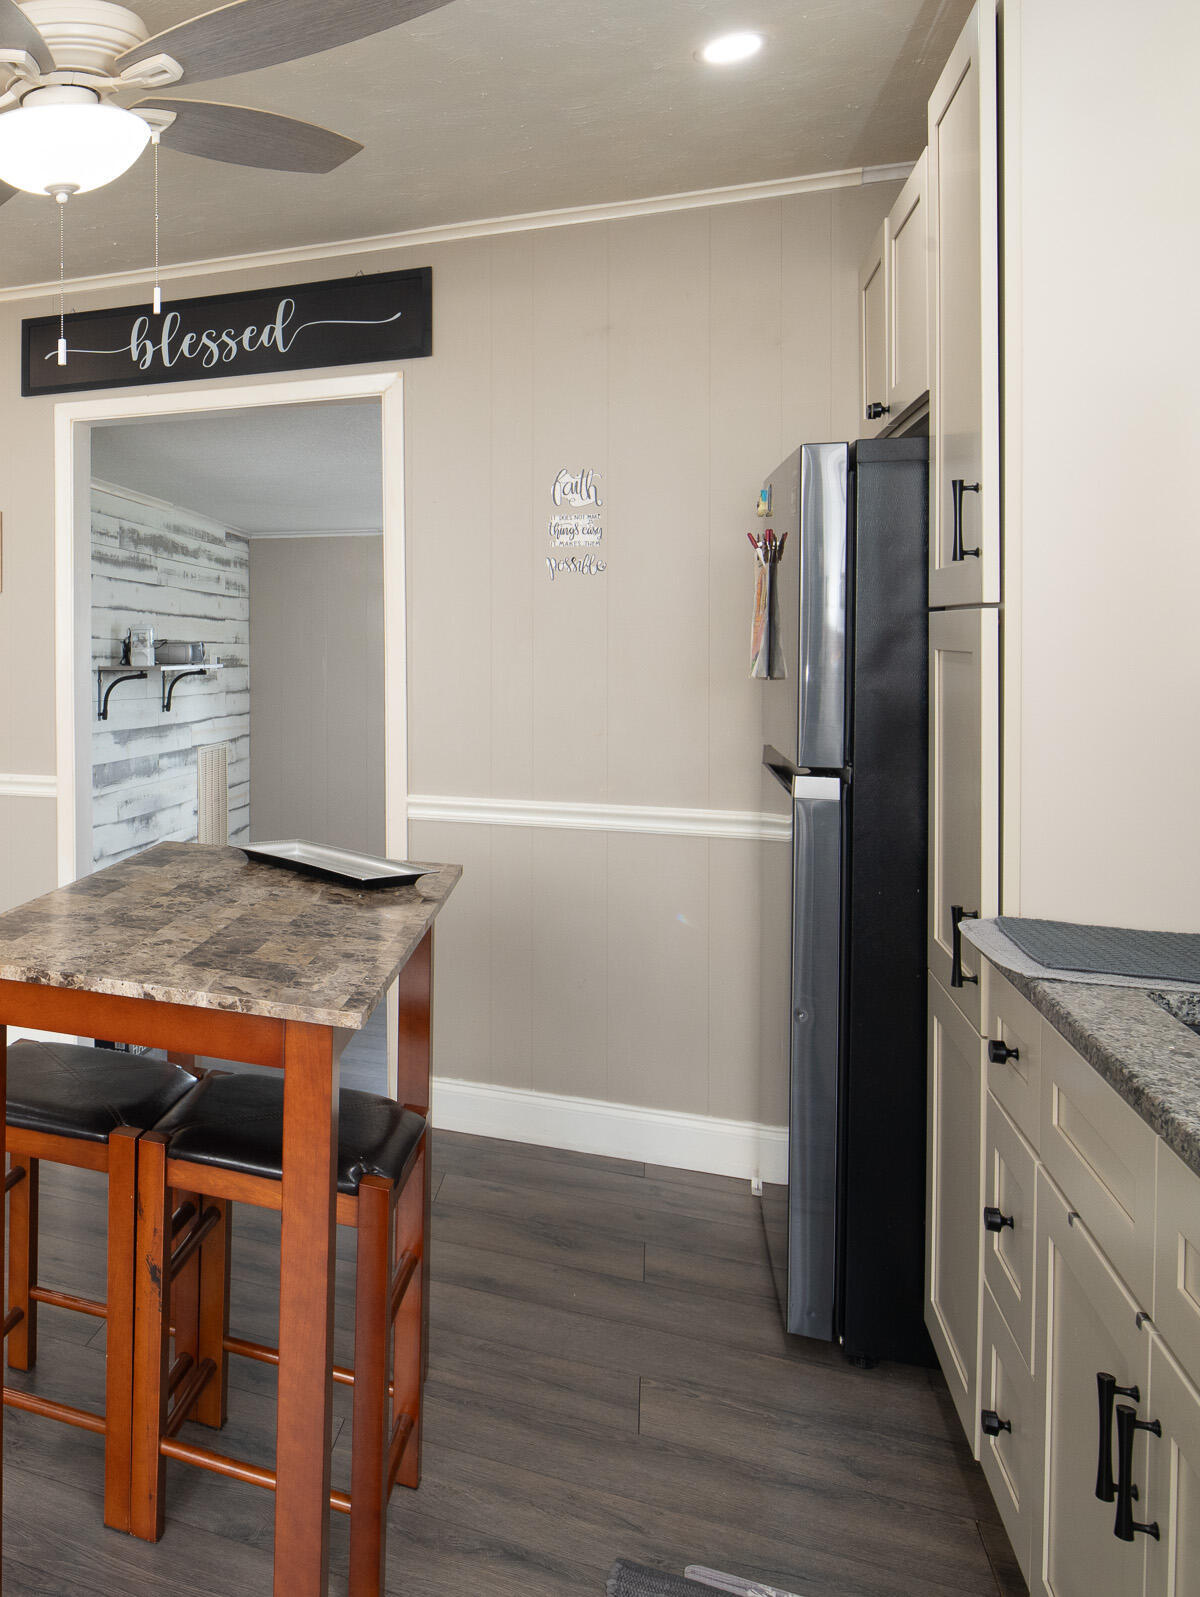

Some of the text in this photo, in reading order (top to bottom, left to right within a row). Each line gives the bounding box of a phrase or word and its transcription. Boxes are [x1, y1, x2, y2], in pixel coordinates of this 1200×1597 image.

[130, 298, 295, 370] blessed
[553, 469, 602, 507] faith
[546, 554, 607, 581] possible
